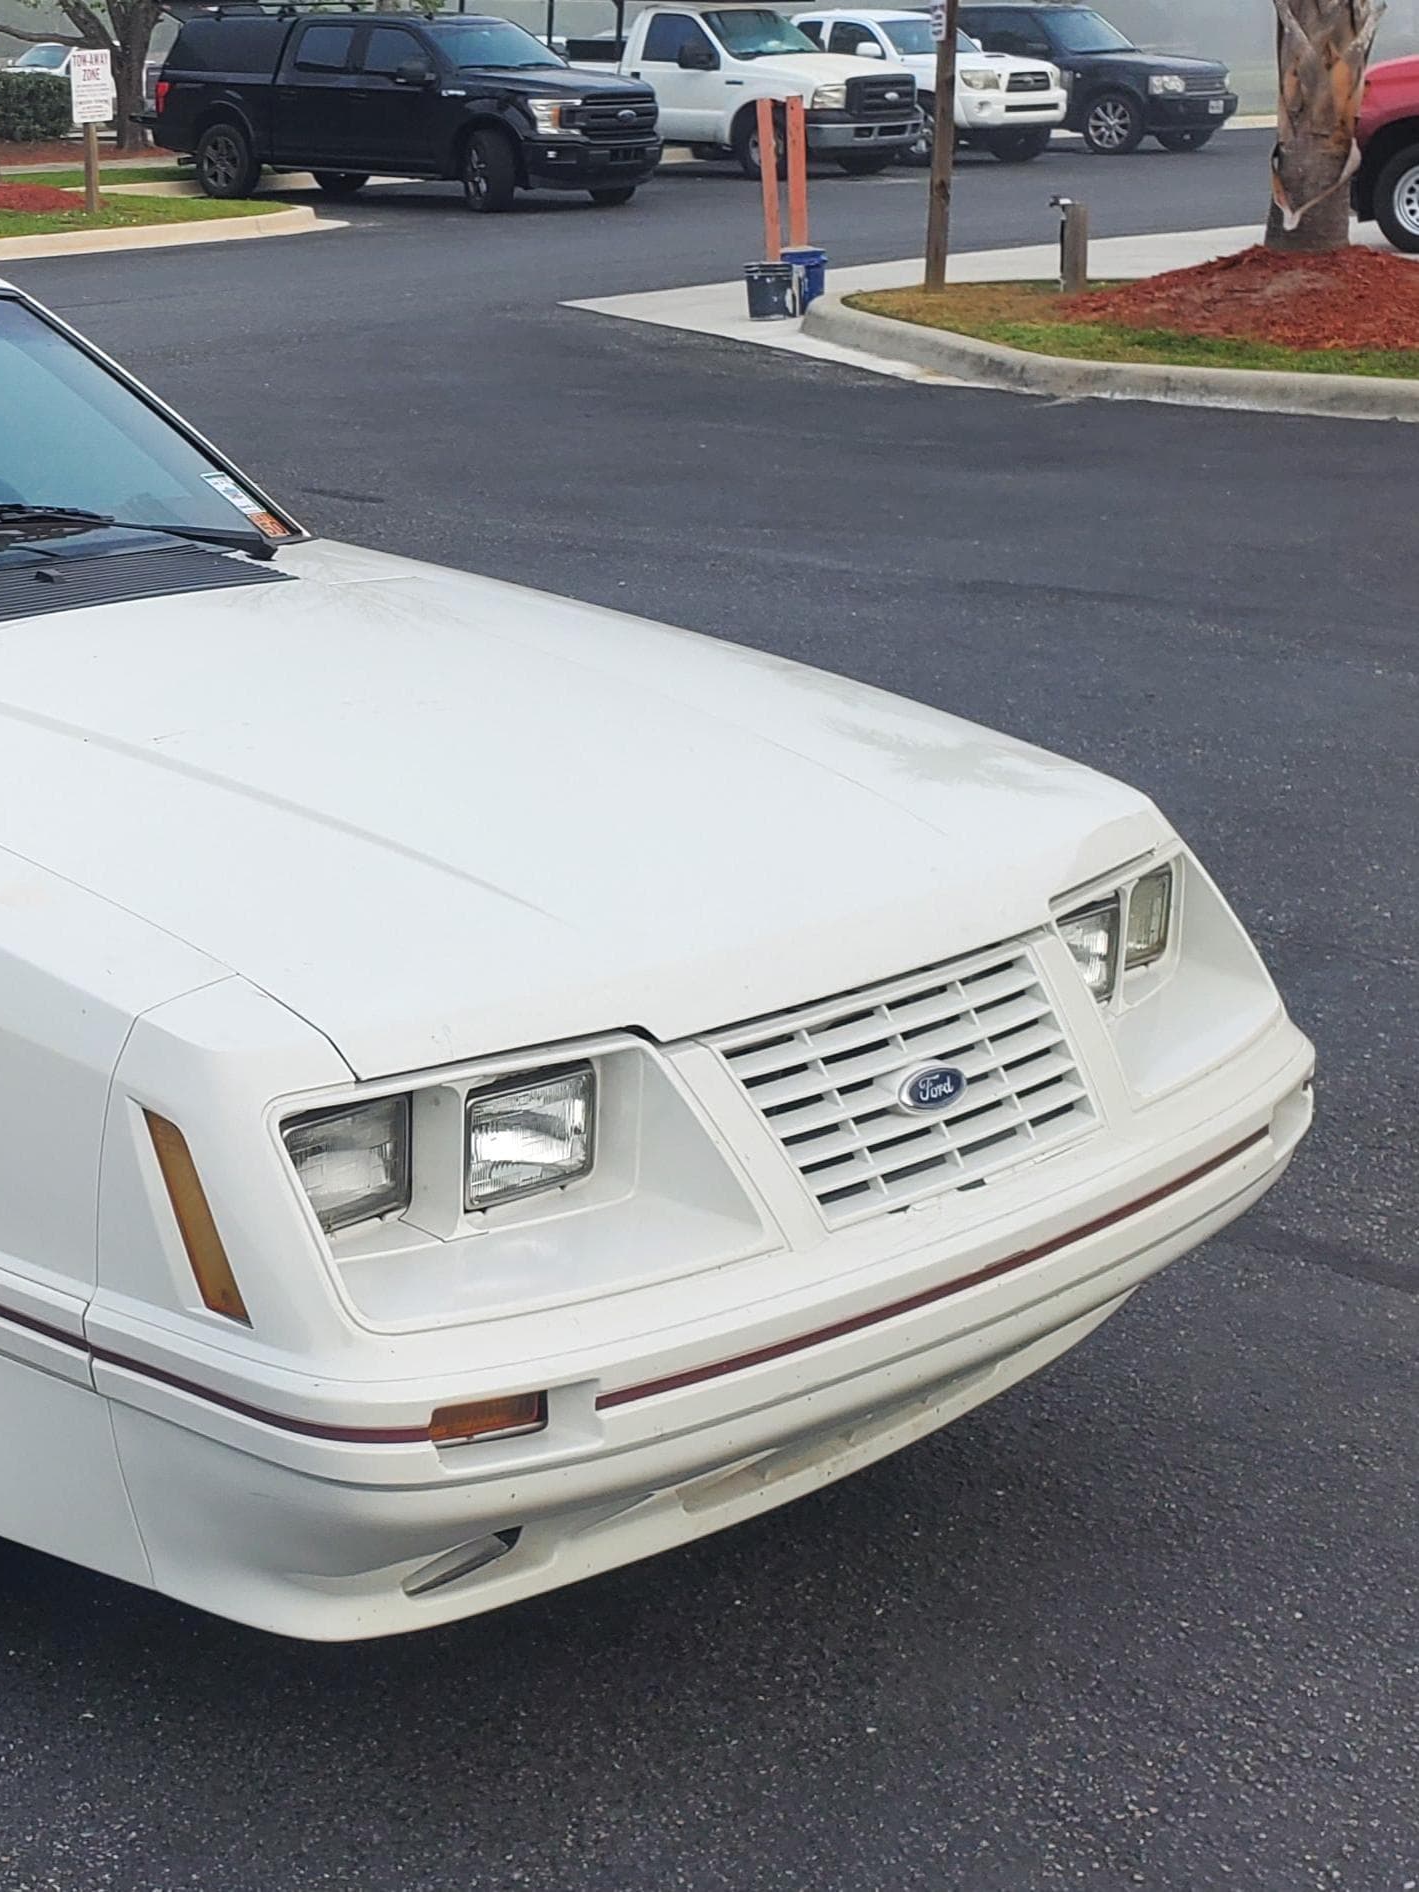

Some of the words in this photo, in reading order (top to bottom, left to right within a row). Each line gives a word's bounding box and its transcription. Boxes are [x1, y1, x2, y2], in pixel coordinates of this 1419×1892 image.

[72, 53, 109, 67] TOW-AWAY
[82, 68, 101, 81] ZONE
[919, 1074, 955, 1101] Ford
